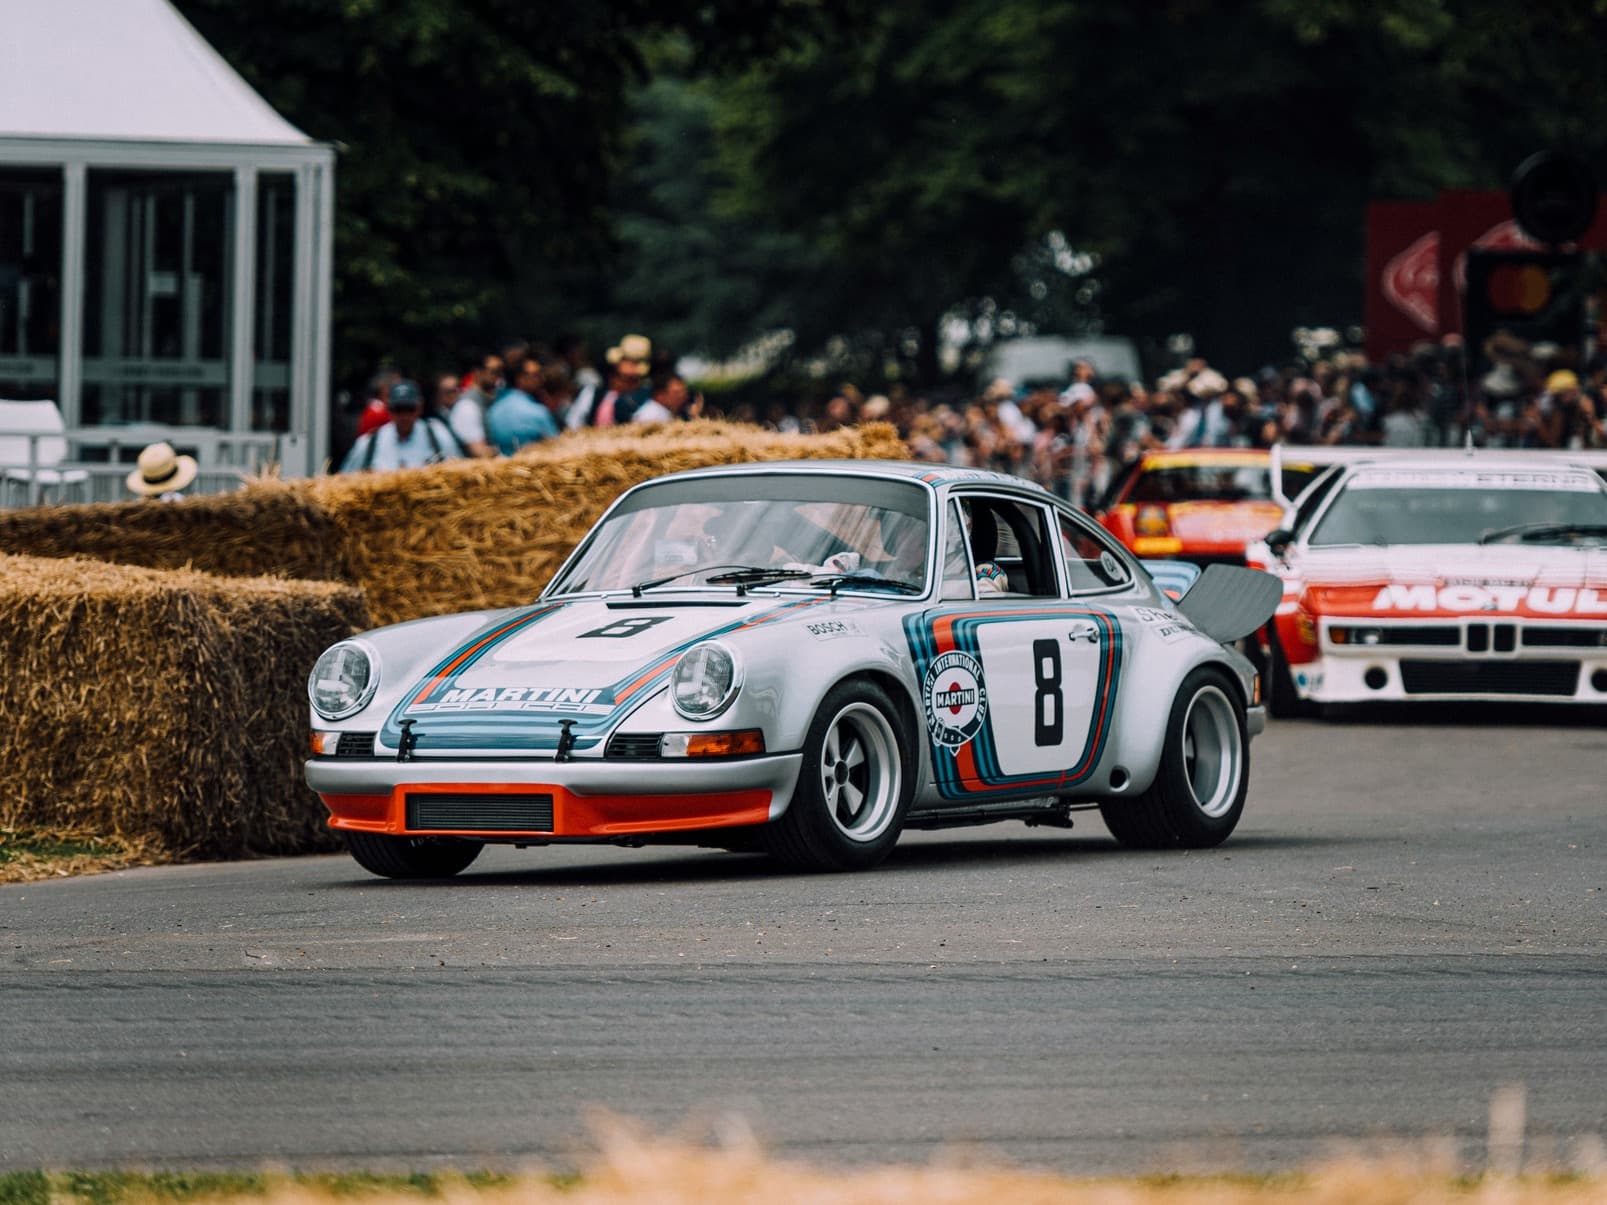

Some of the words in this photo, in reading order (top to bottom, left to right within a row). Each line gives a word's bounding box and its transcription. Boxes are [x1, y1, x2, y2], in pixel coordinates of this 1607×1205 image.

[1372, 584, 1607, 614] MOTUL
[575, 616, 675, 638] 8
[807, 620, 848, 635] BOSCH
[439, 687, 603, 704] MARTINI
[937, 691, 974, 707] MARTINI
[1033, 639, 1064, 747] 8
